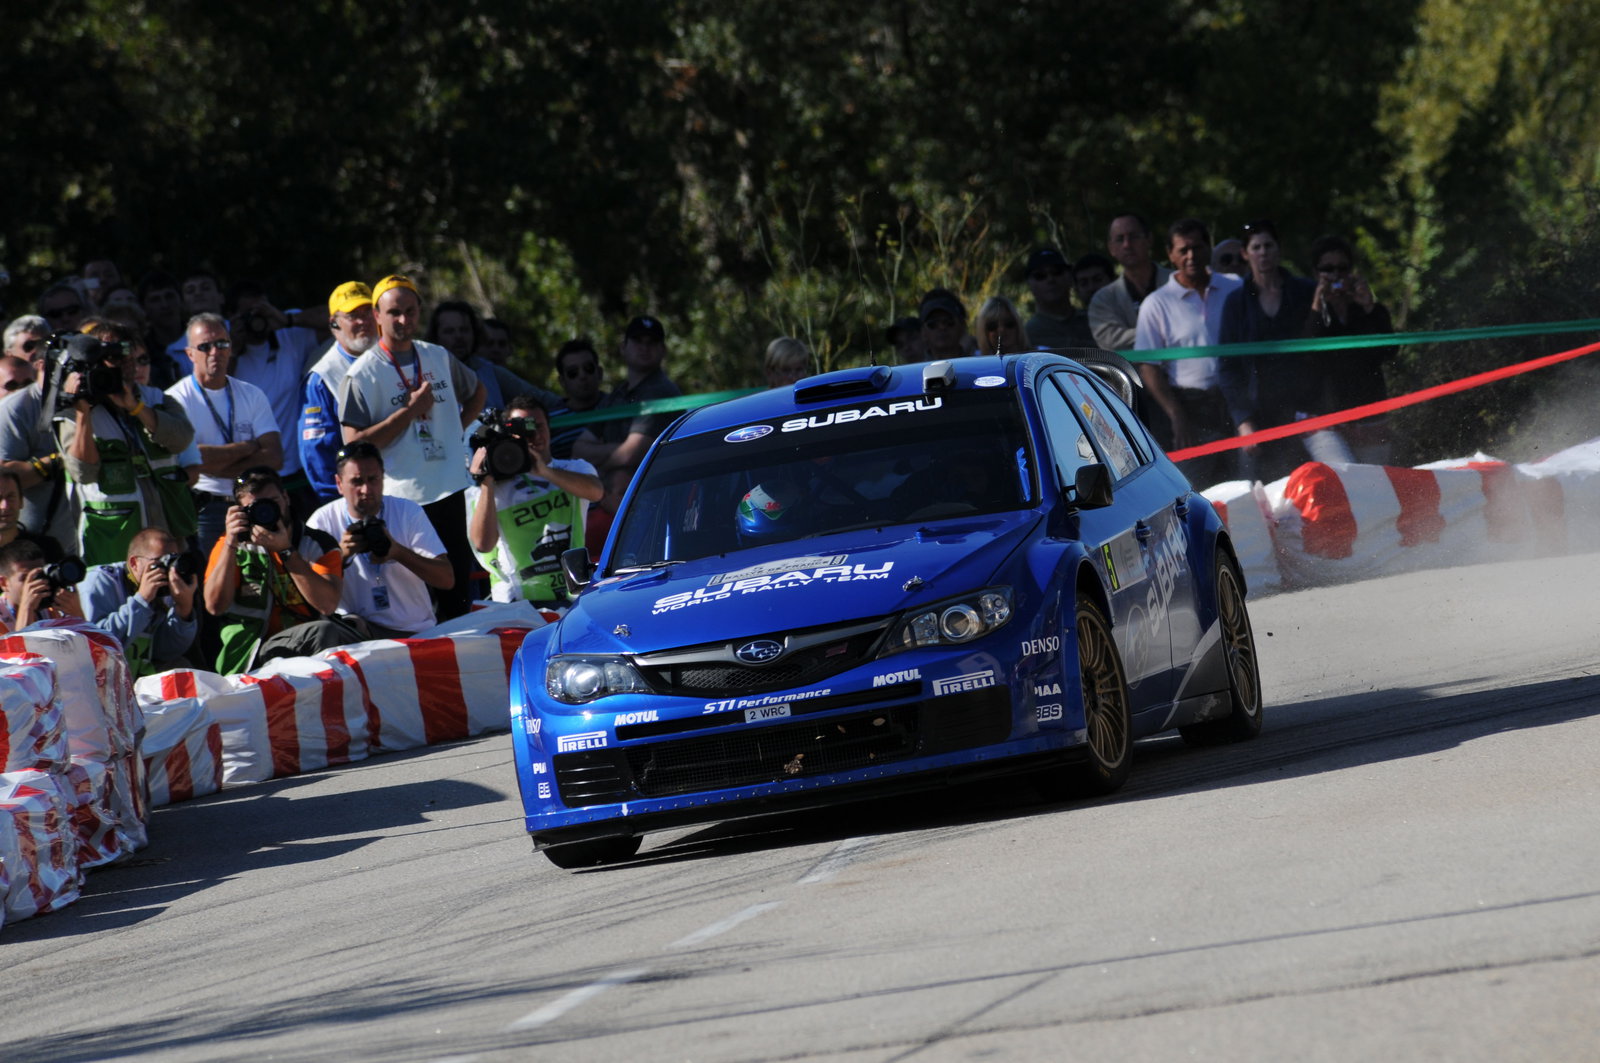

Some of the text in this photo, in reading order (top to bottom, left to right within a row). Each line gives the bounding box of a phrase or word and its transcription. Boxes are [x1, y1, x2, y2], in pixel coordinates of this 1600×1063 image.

[781, 397, 942, 433] SUBARU
[550, 573, 566, 587] 20
[653, 561, 895, 609] SUBARU
[651, 572, 890, 615] WORLD RALLY TEAM
[1021, 635, 1060, 656] DENSO
[873, 668, 922, 687] MOTUL
[932, 669, 995, 696] PIRELLI
[702, 688, 832, 714] STI Performance
[614, 710, 659, 726] MOTUL
[749, 705, 786, 720] 2 WRC
[557, 731, 608, 752] PIRELLI
